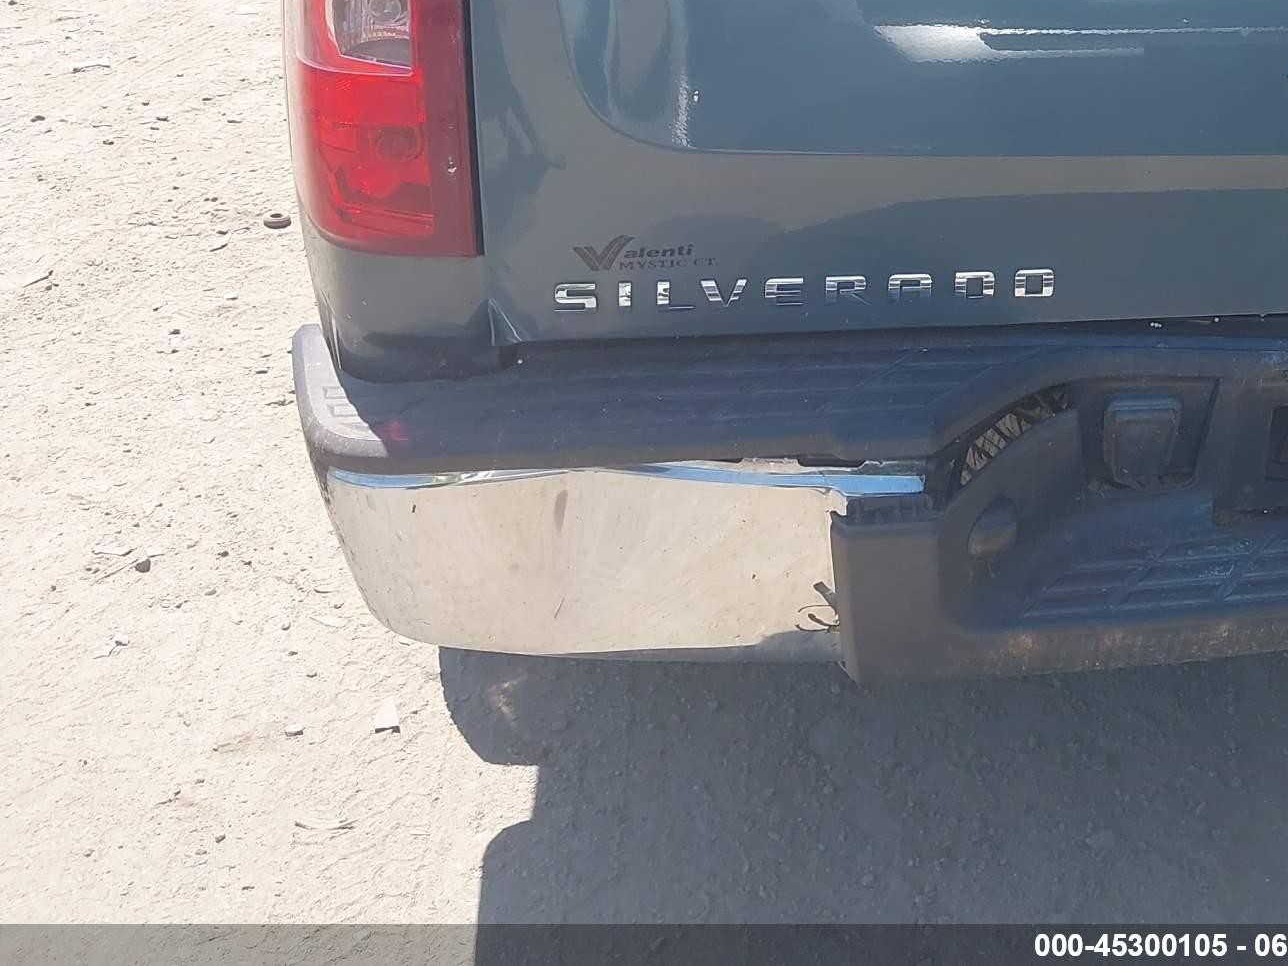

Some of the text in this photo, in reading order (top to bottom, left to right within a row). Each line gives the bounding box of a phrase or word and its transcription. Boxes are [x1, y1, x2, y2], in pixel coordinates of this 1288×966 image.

[573, 235, 694, 271] Valenti
[619, 258, 689, 270] MYSTIC
[553, 268, 1055, 313] SILVERADO
